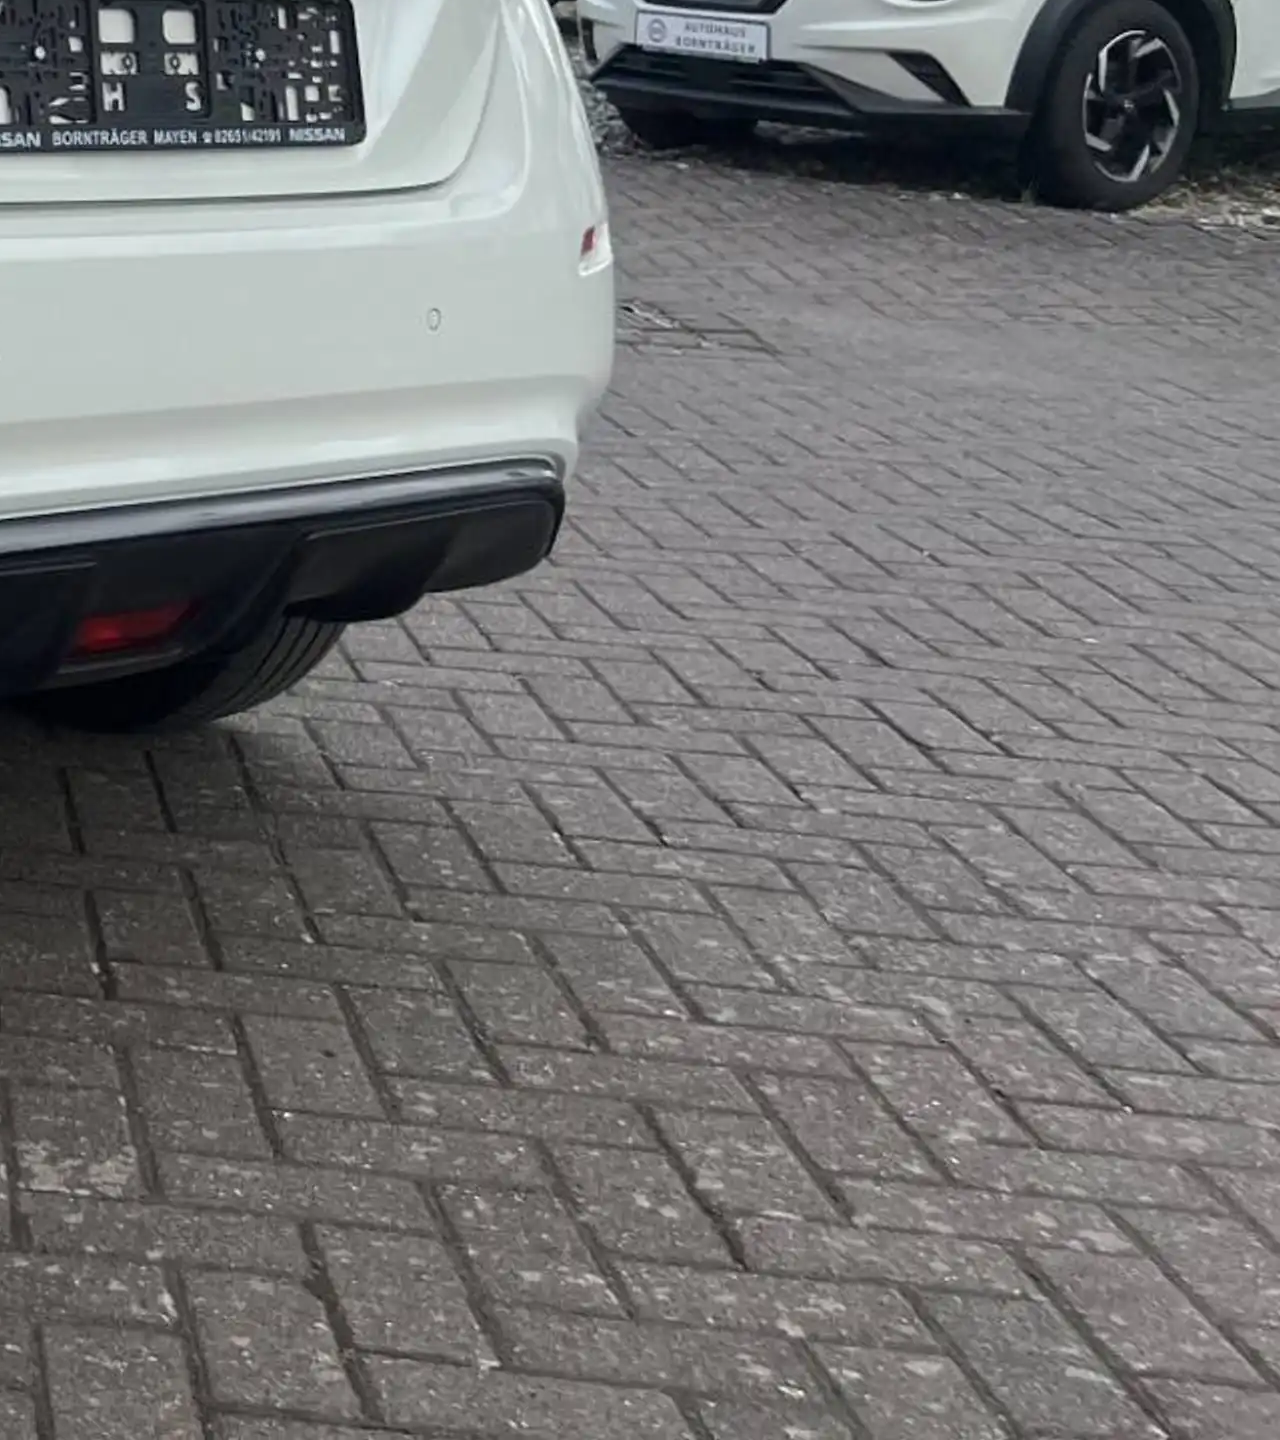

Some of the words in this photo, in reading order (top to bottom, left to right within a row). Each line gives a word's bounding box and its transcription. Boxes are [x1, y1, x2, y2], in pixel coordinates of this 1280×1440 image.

[51, 127, 148, 146] BORNTRÄGER
[153, 127, 198, 145] MAYEN
[289, 126, 345, 142] NISSAN
